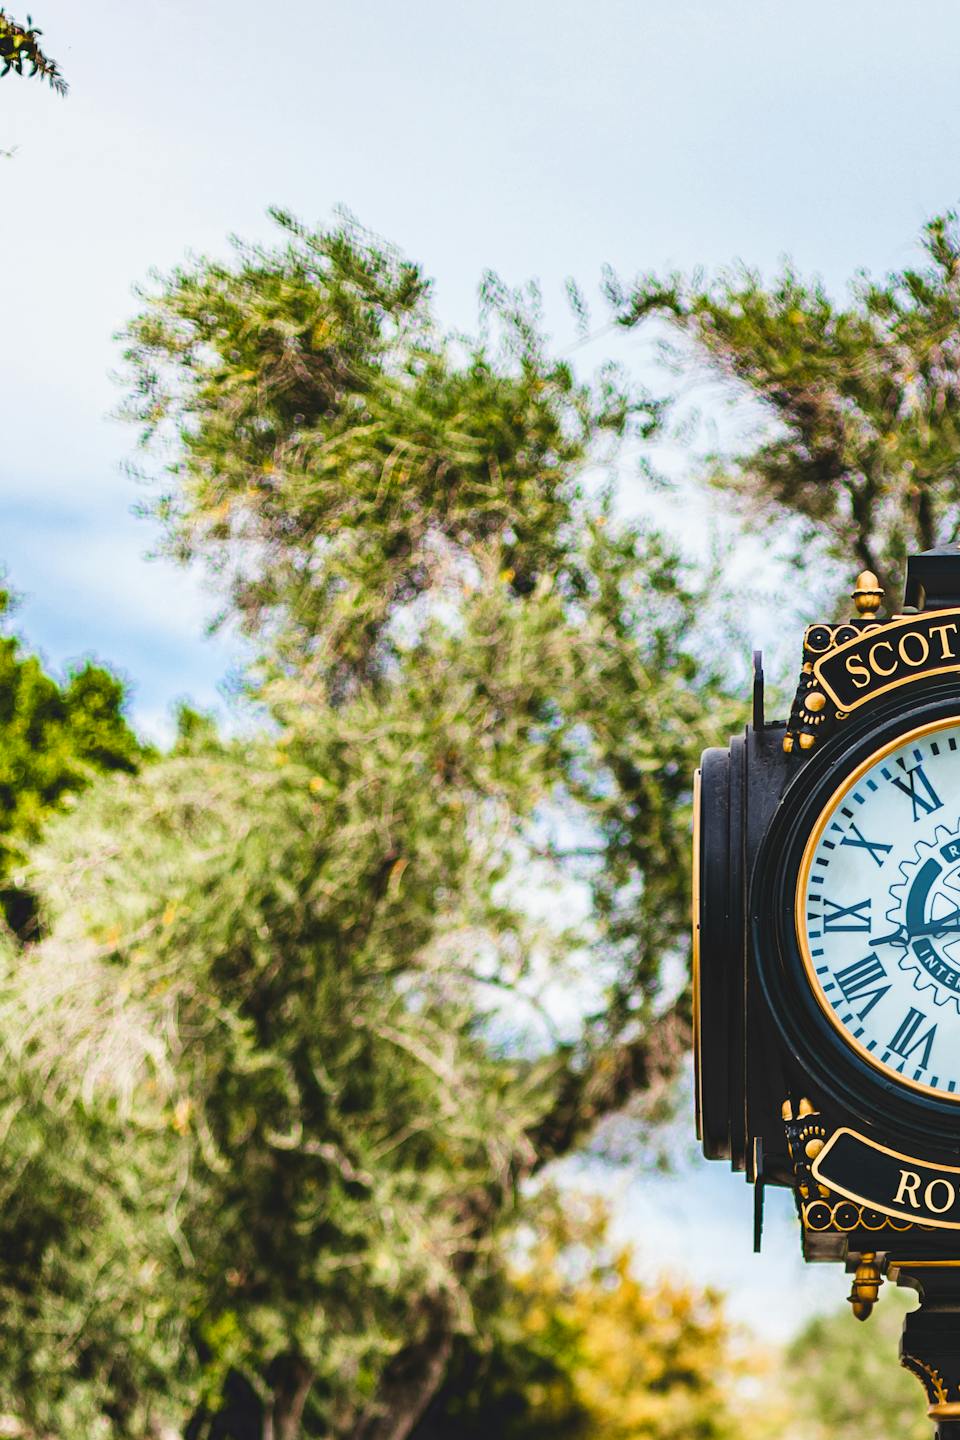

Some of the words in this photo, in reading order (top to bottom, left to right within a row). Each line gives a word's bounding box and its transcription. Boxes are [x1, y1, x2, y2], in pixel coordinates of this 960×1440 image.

[891, 764, 944, 822] XI
[840, 823, 893, 867] X
[823, 898, 872, 933] IX
[833, 952, 893, 1021] VIII
[886, 1006, 938, 1070] VII
